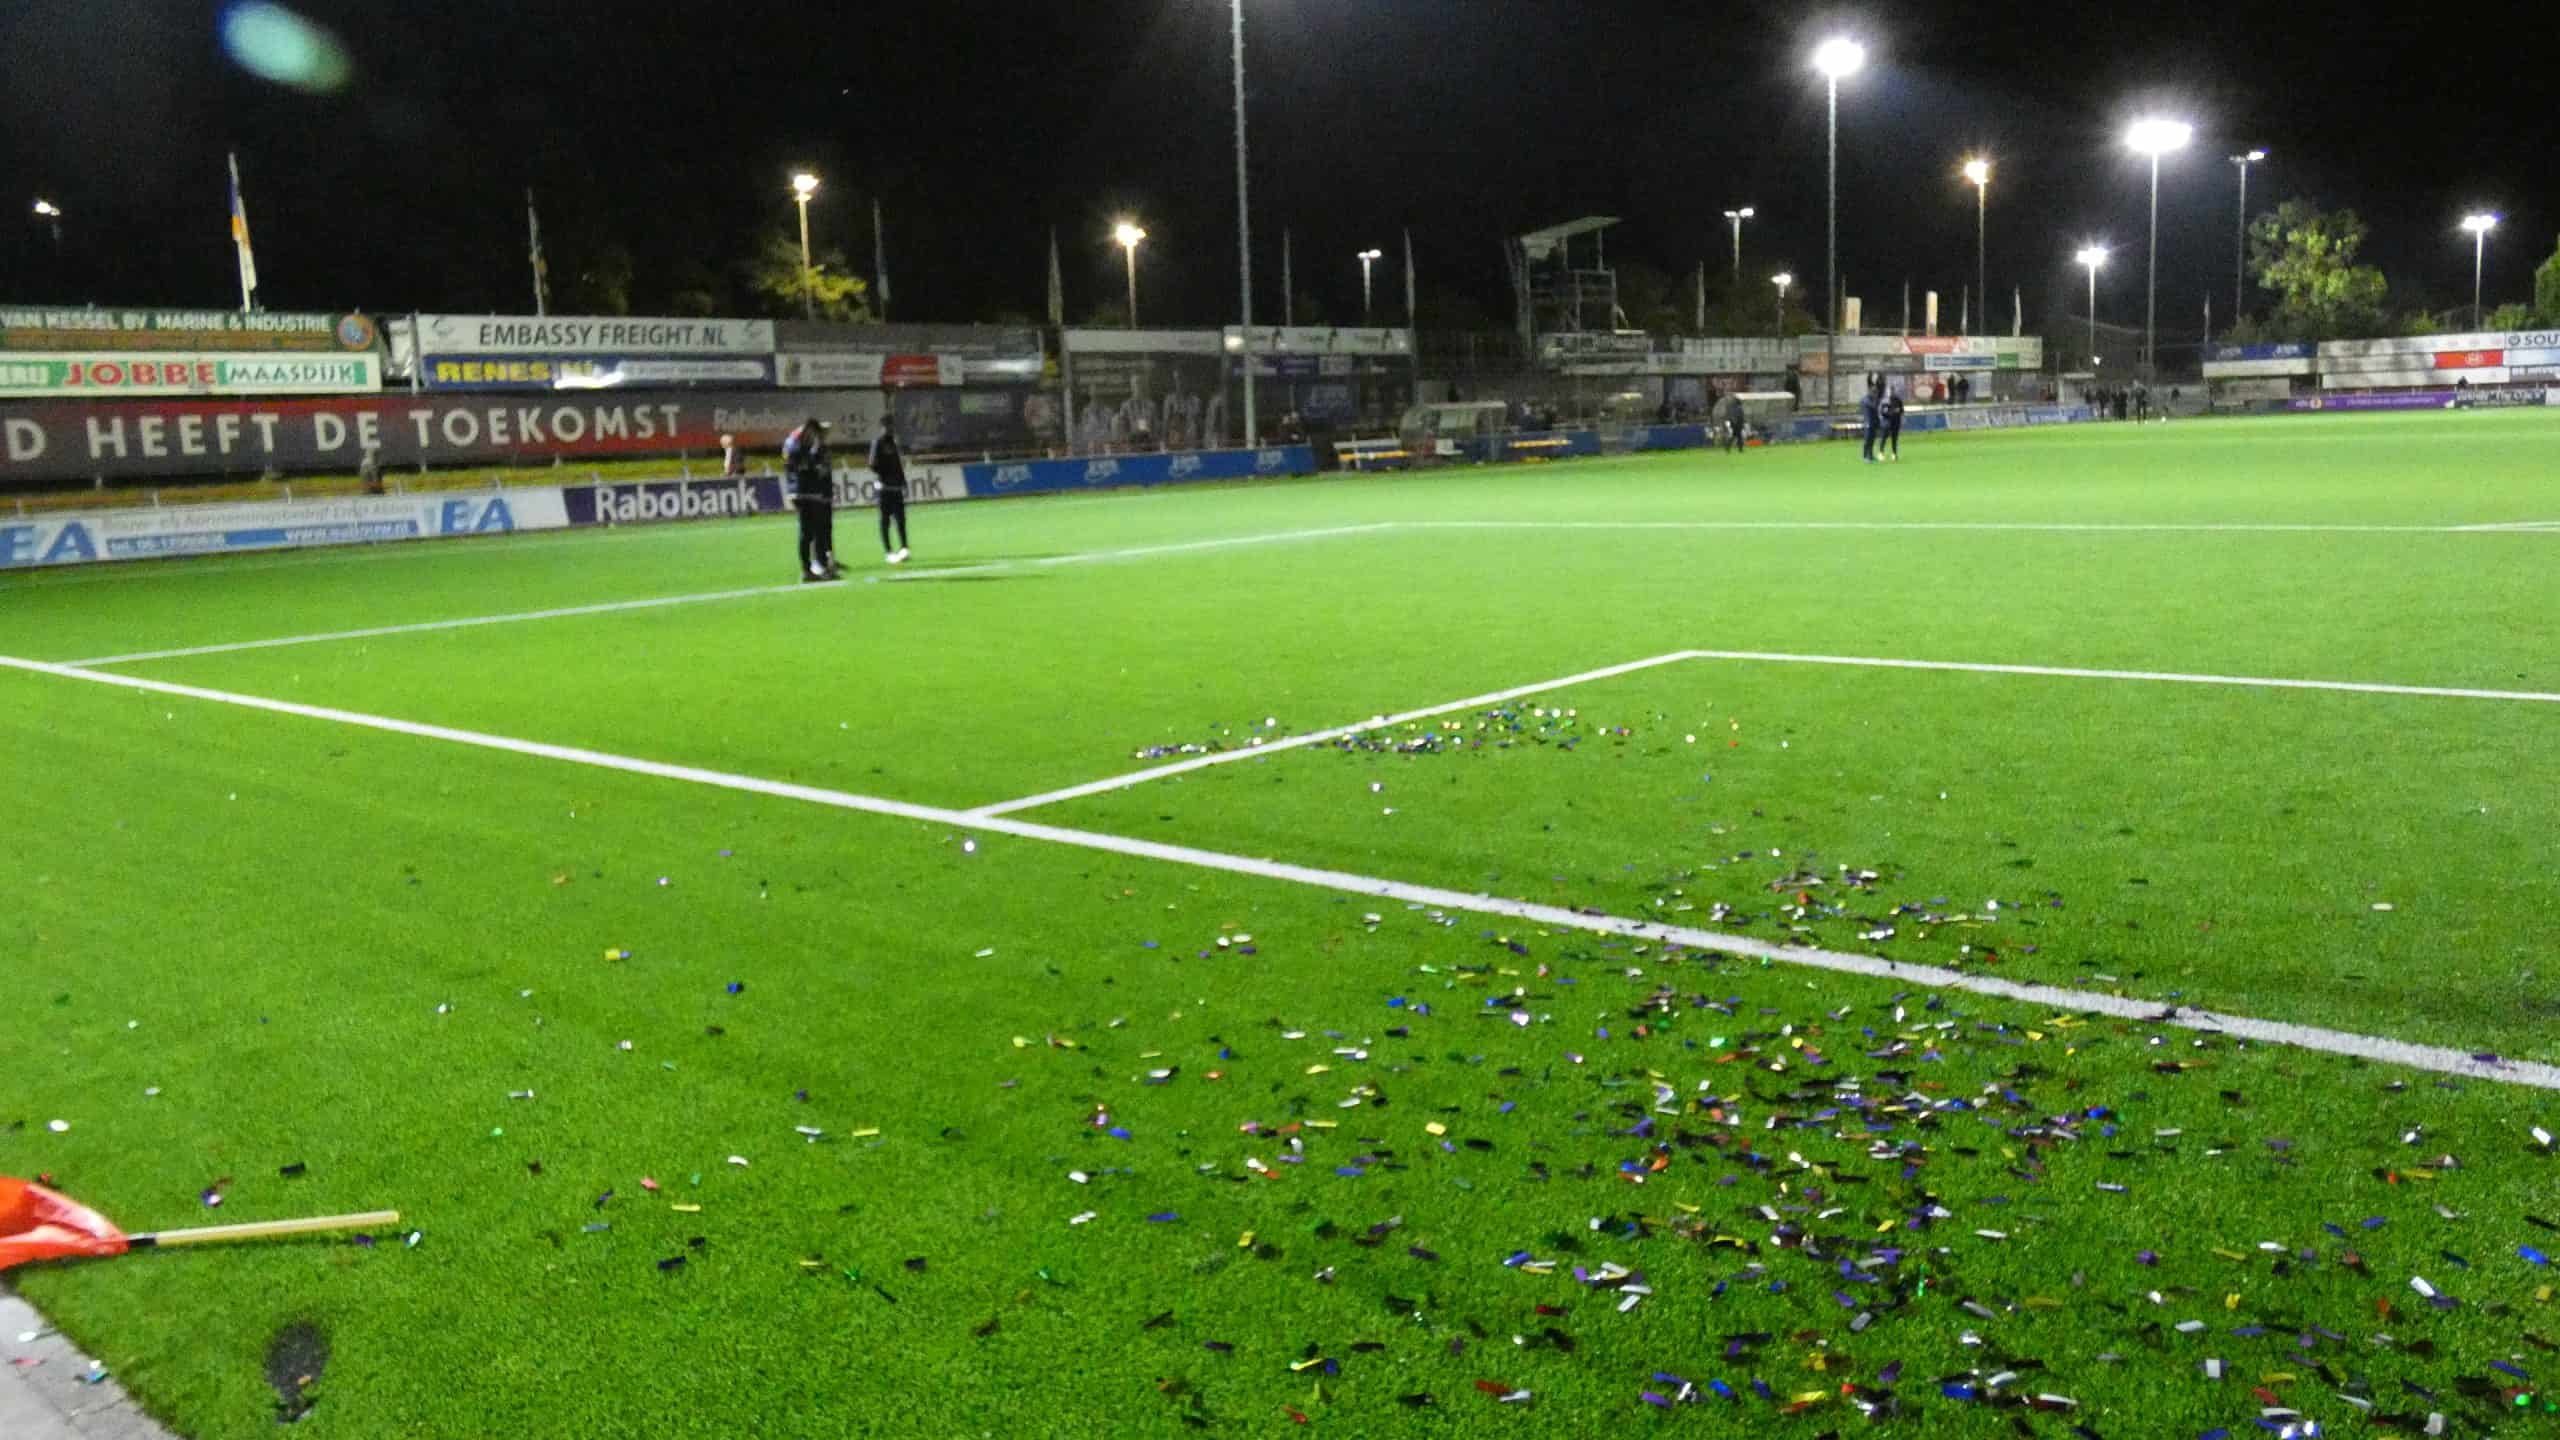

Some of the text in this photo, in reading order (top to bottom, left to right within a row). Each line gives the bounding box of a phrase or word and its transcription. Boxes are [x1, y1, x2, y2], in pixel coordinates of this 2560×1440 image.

[1, 312, 43, 328] VAN
[46, 312, 118, 330] KESSEL
[156, 314, 225, 331] MARINE
[229, 316, 242, 330] &
[245, 315, 331, 332] INDUSTRIE
[64, 362, 218, 386] JOBBE
[228, 365, 353, 385] MAASDIJK
[86, 412, 279, 459] HEEFT
[314, 411, 382, 452] DE
[408, 404, 681, 449] TOEKOMST
[440, 498, 514, 535] EA
[594, 483, 758, 524] Rabobank
